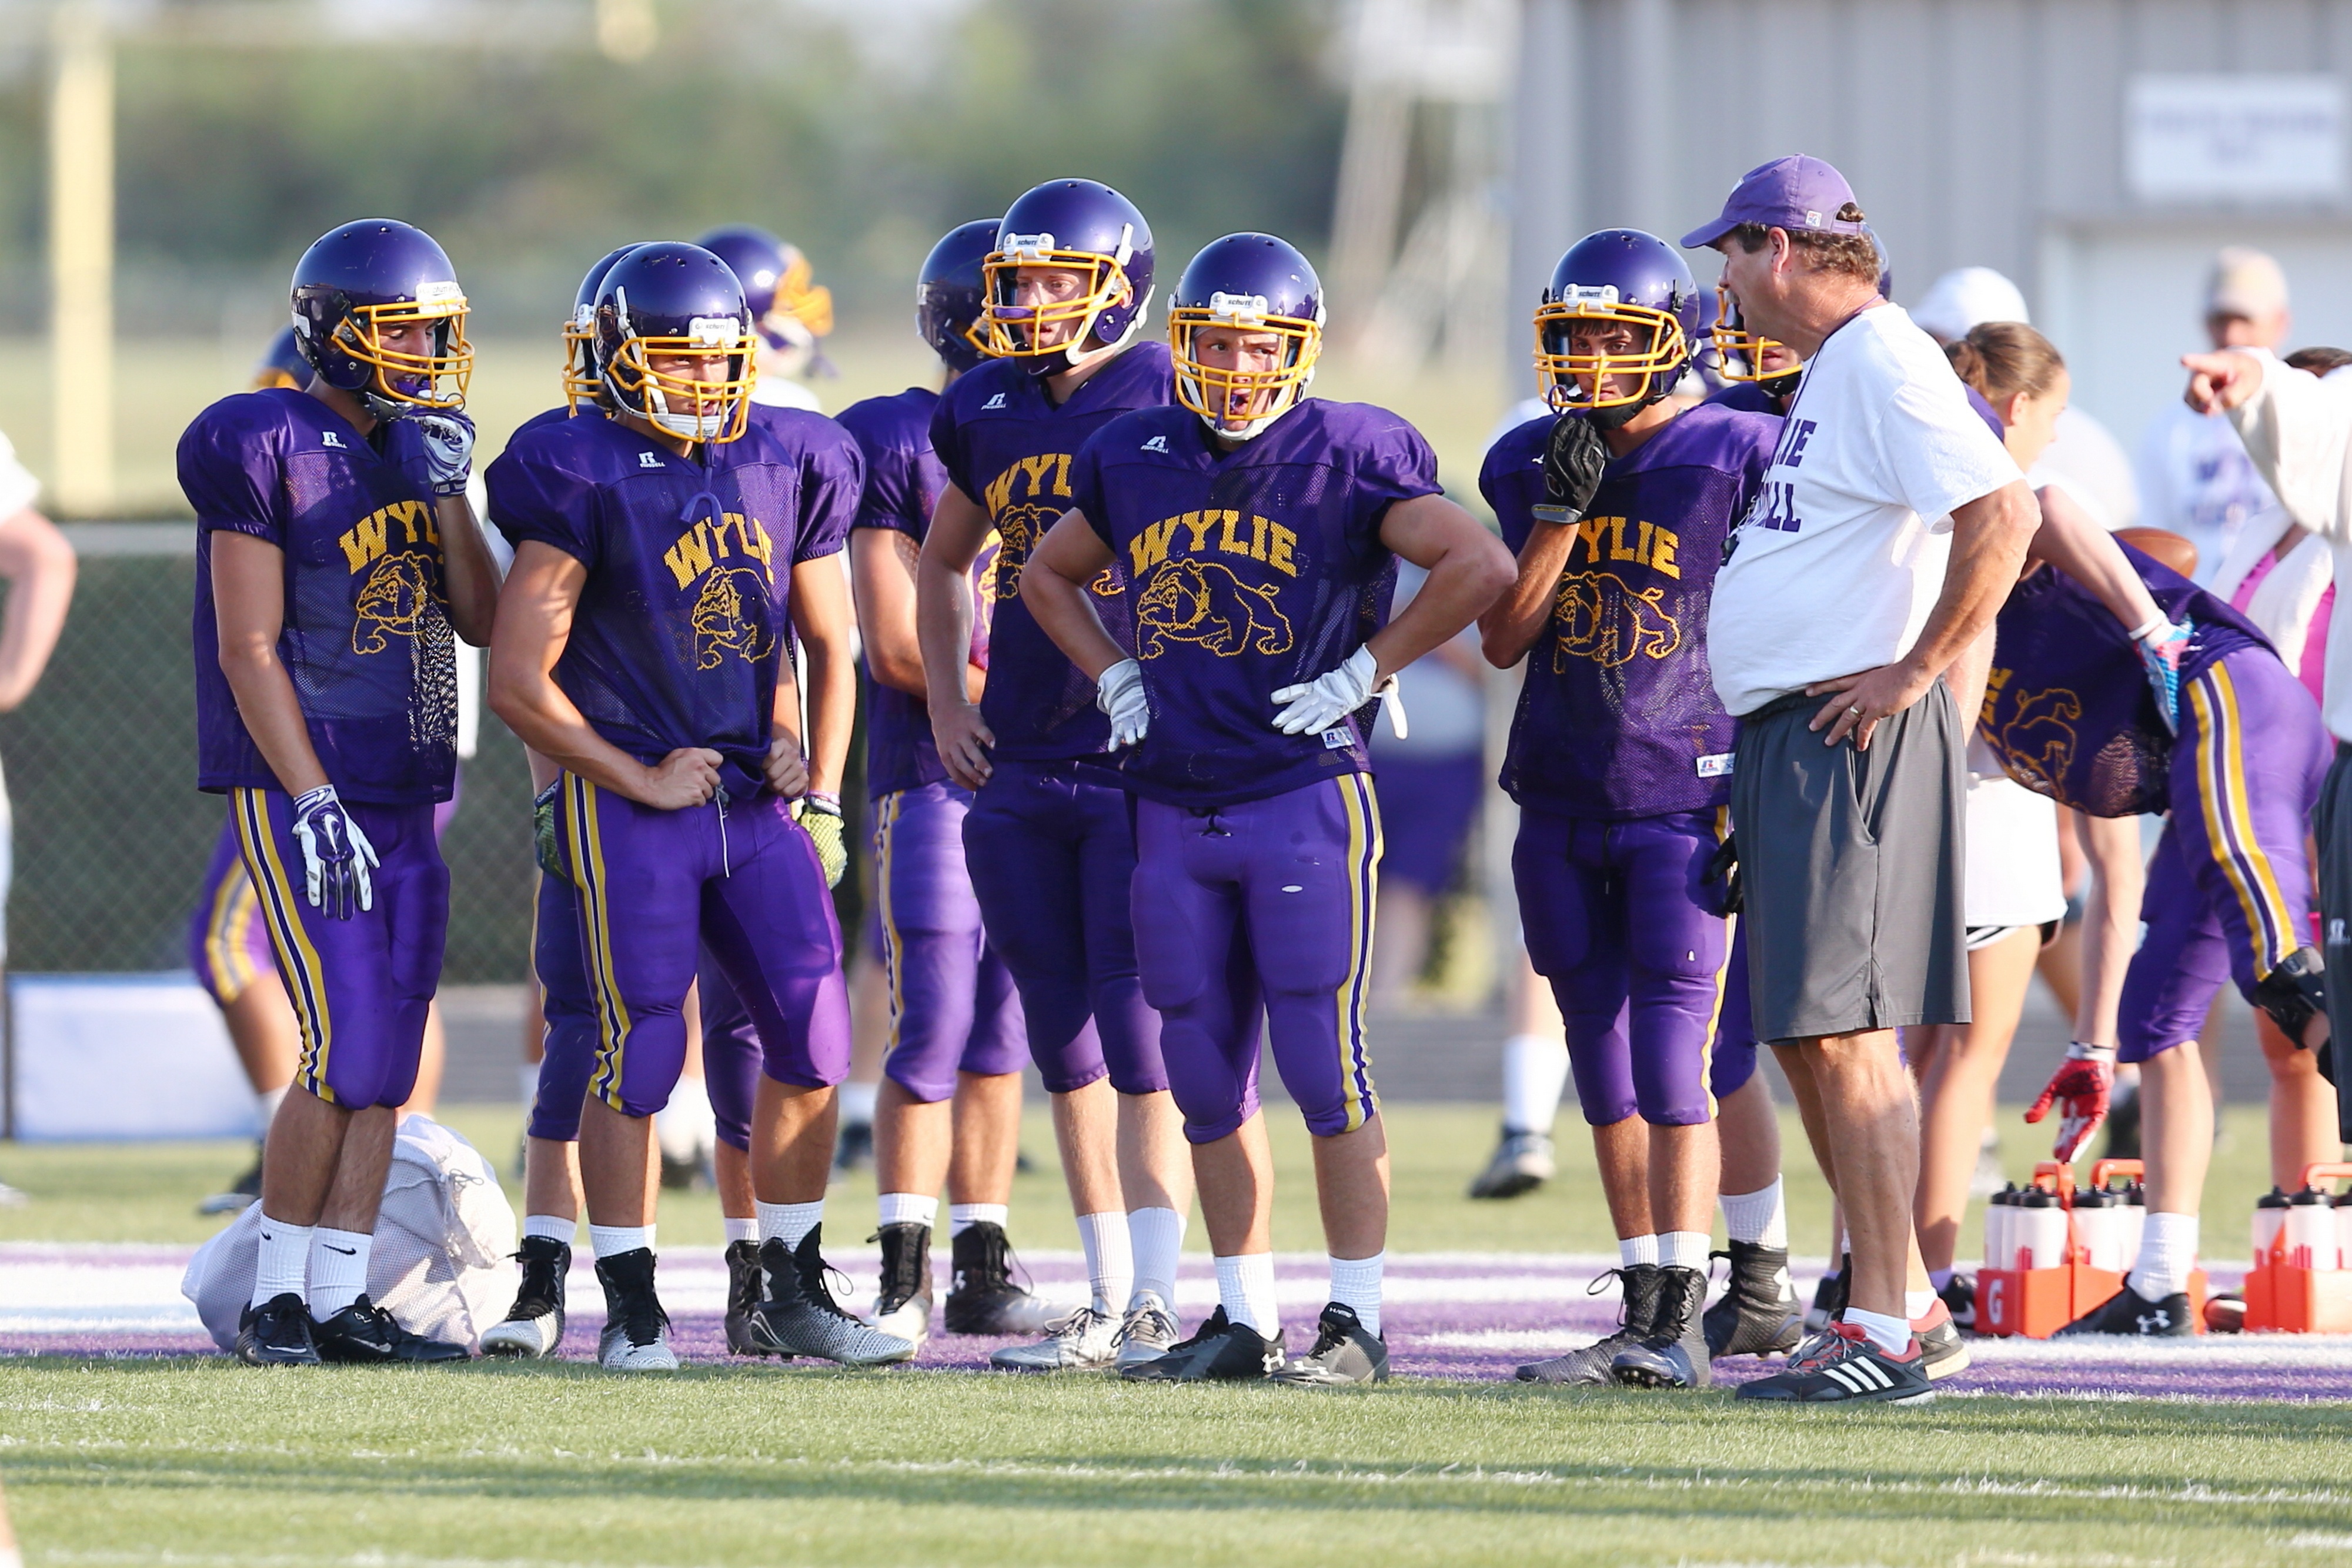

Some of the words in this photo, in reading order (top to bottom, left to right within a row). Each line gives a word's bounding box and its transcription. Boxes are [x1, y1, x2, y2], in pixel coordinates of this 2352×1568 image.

[984, 453, 1073, 522] WYL
[339, 500, 443, 575] WYL
[1129, 508, 1297, 579] WYLIE
[1578, 516, 1681, 580] YLIE
[1987, 1278, 2003, 1325] G
